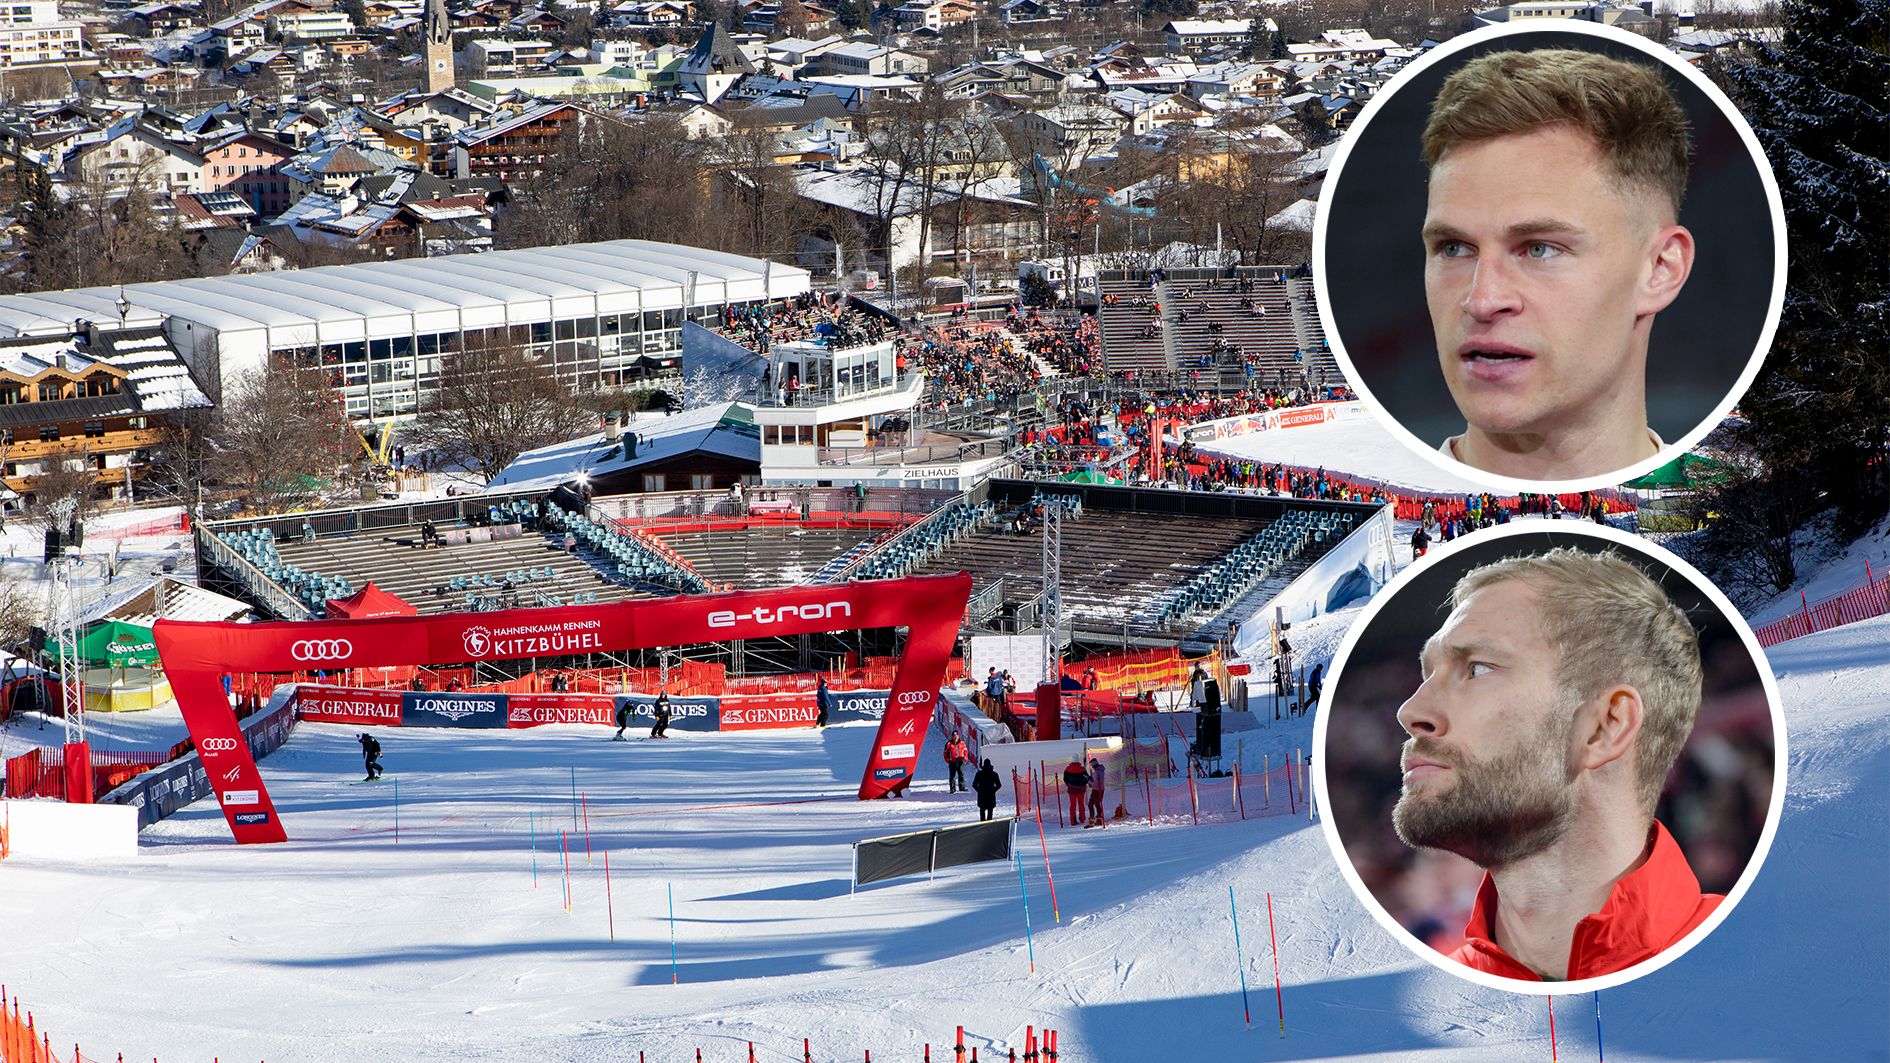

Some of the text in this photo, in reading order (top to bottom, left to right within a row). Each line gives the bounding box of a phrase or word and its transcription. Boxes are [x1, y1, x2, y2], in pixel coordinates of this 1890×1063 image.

[1290, 412, 1324, 424] GENERALI
[904, 468, 959, 478] ZIELHAUS
[707, 601, 851, 627] e-tron
[493, 620, 601, 636] HAHNENKAMM RENNEN
[494, 632, 603, 656] KITZBÜHEL
[322, 700, 400, 718] GENERALI
[415, 699, 496, 713] LONGINES
[533, 708, 612, 723] GENERALI
[745, 706, 821, 723] GENERAL
